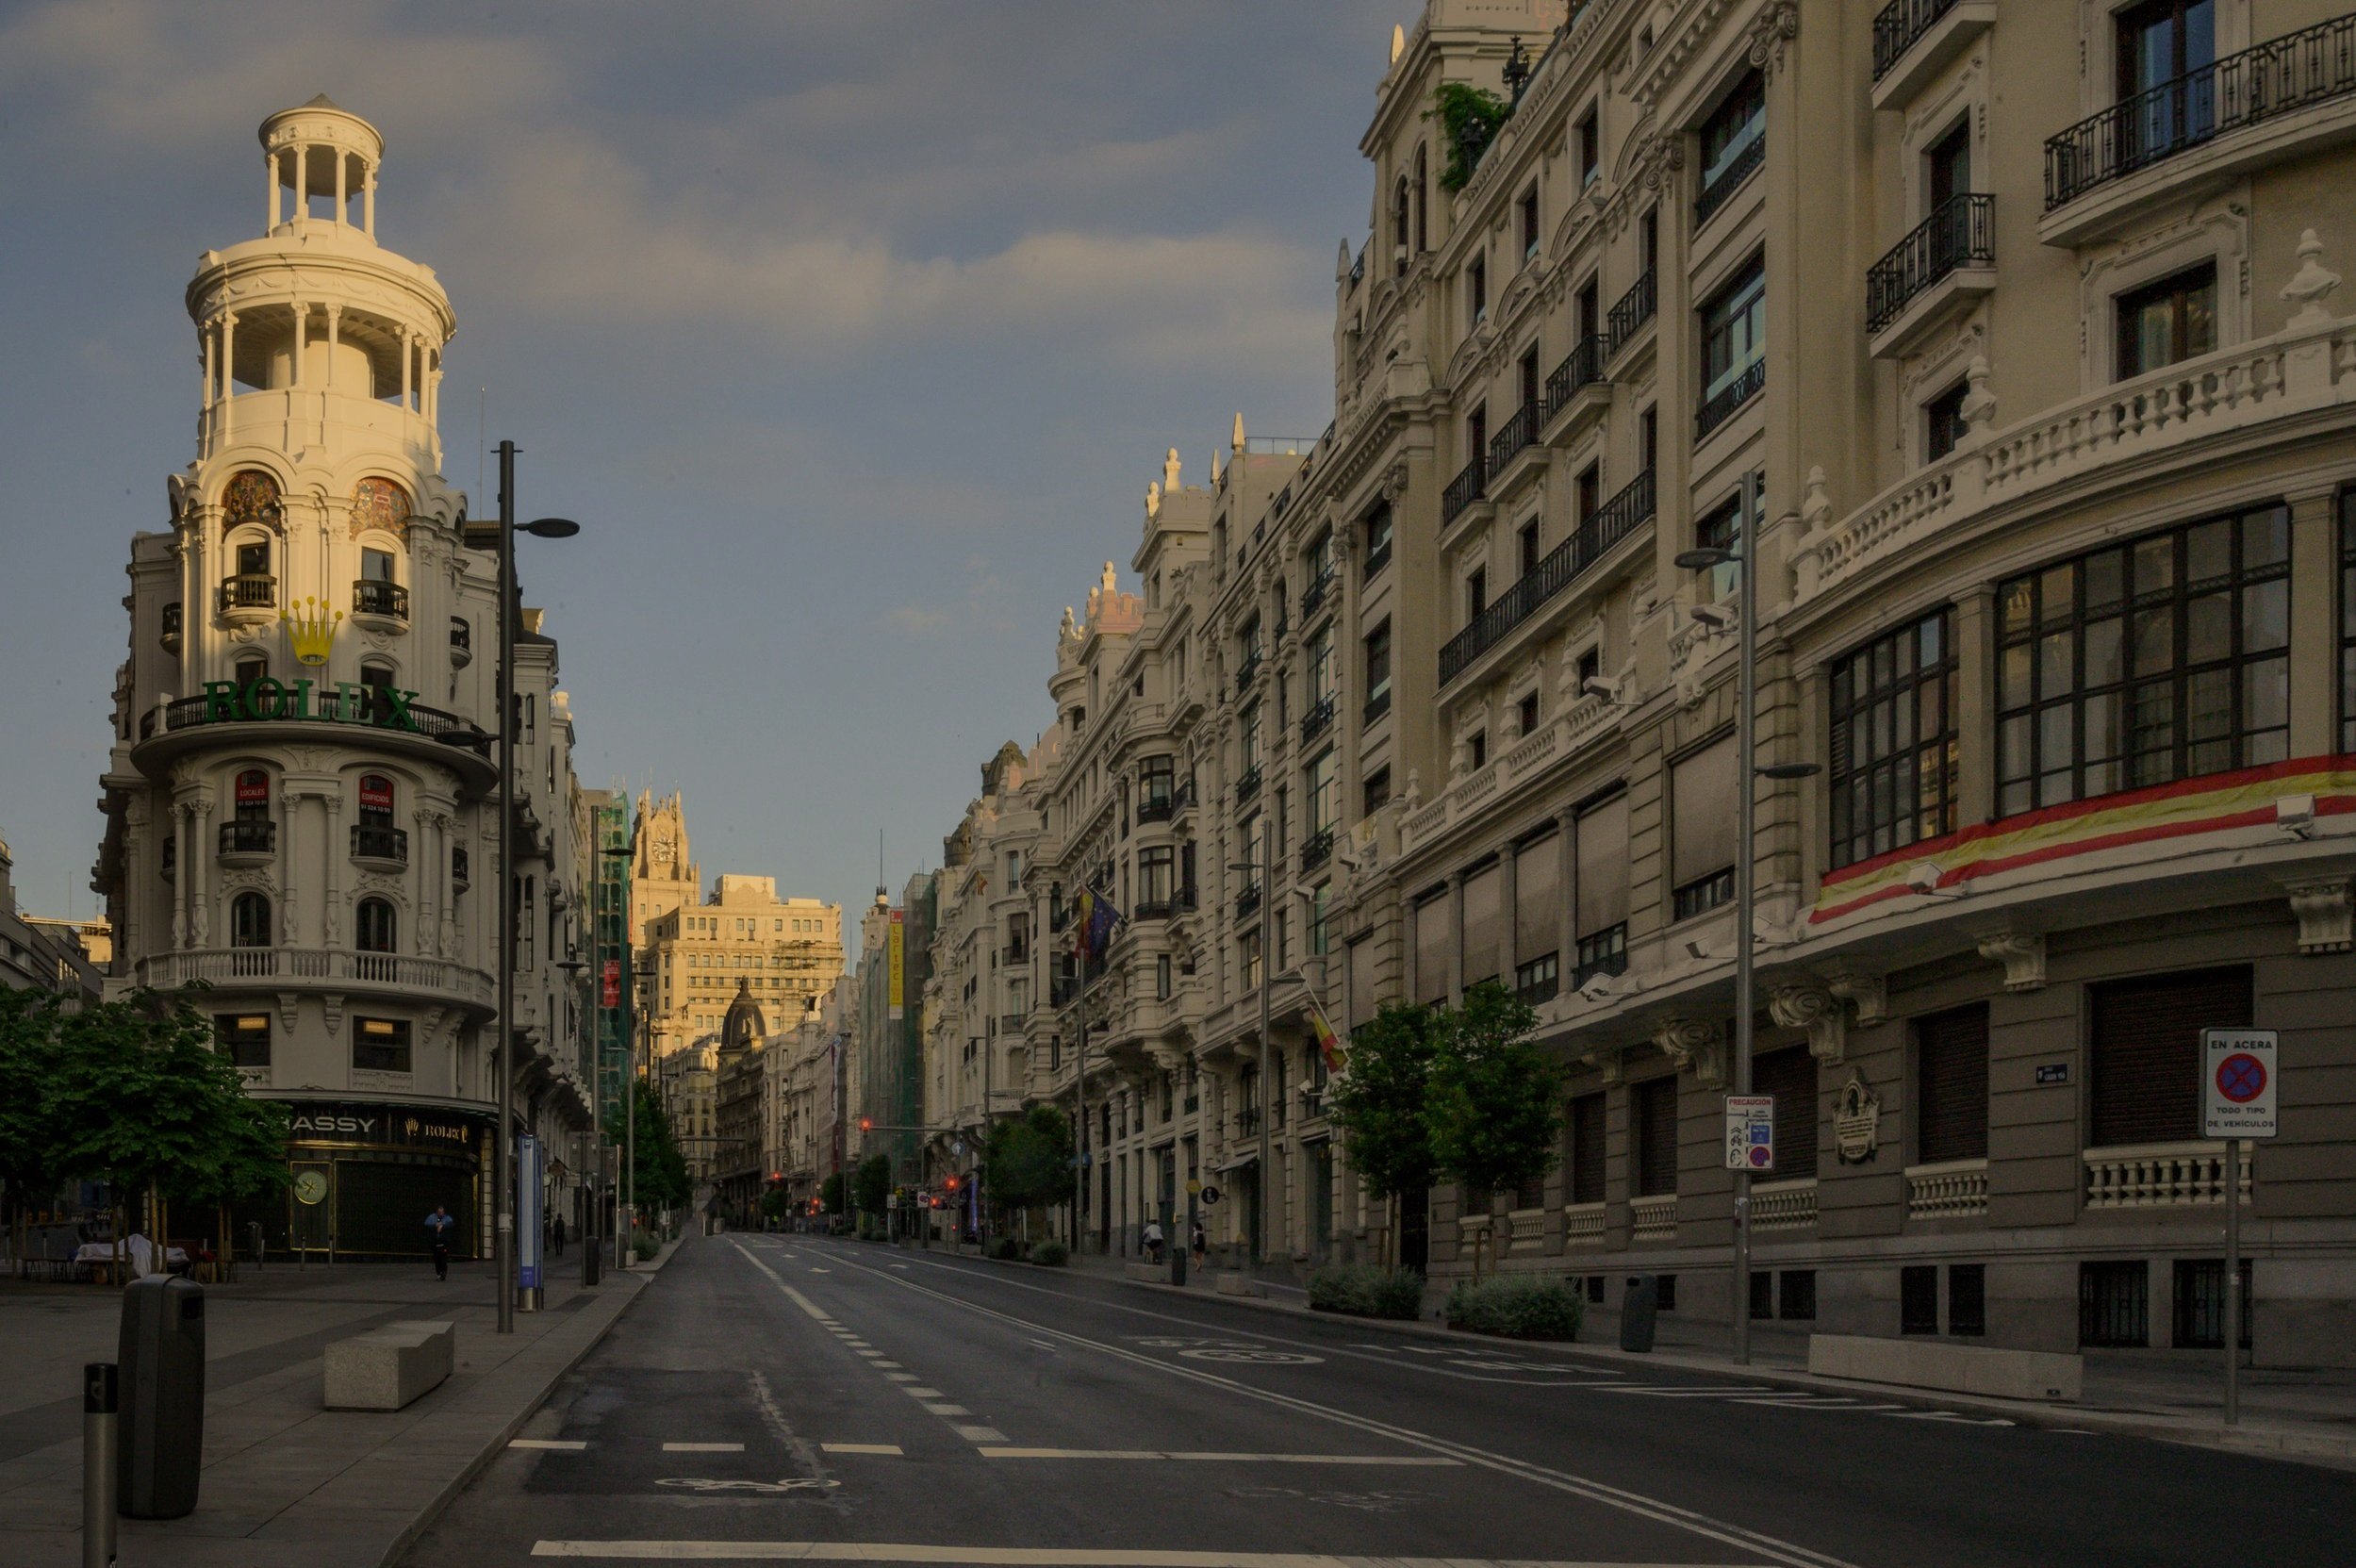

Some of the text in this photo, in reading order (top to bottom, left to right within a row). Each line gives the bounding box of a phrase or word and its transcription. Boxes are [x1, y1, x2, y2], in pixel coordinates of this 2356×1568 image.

[203, 677, 421, 732] ROLEX
[240, 788, 266, 797] LOCALES
[362, 793, 390, 803] EDIFICIOS
[2211, 1040, 2272, 1049] EN ACERA
[1728, 1098, 1771, 1106] PRECAUCIÓN
[2225, 1119, 2275, 1128] VEHÍCULOS
